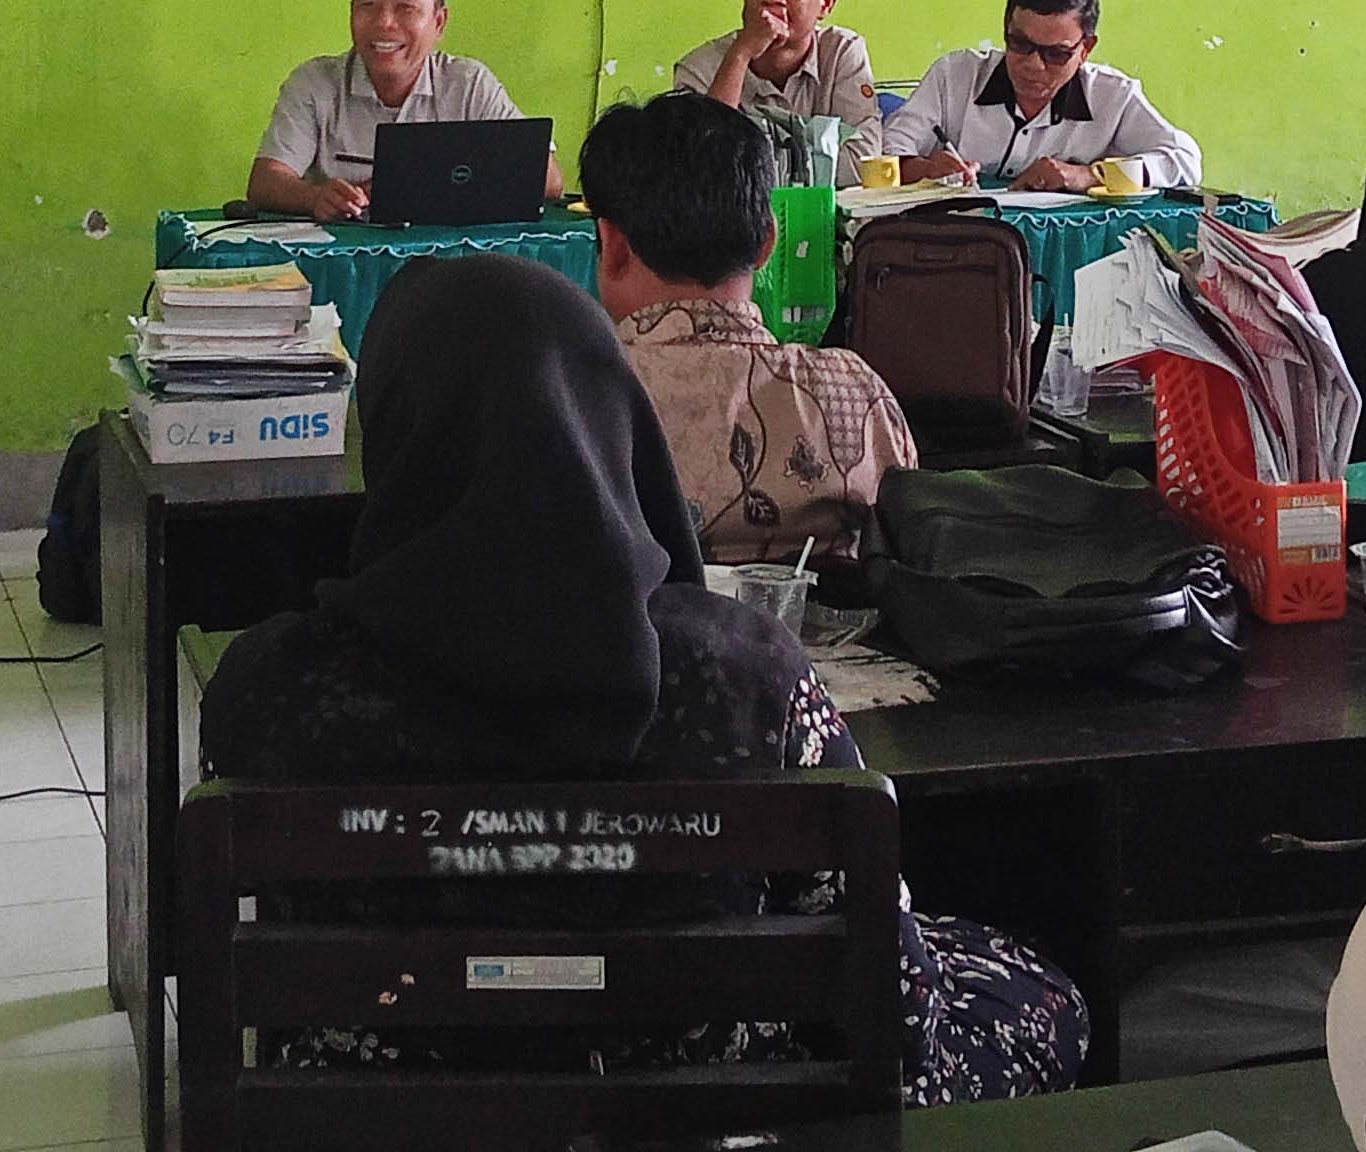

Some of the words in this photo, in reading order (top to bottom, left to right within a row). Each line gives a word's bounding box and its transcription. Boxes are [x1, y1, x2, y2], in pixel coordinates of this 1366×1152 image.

[208, 429, 236, 445] F4
[420, 809, 442, 837] 2
[579, 809, 722, 837] JEROWARU
